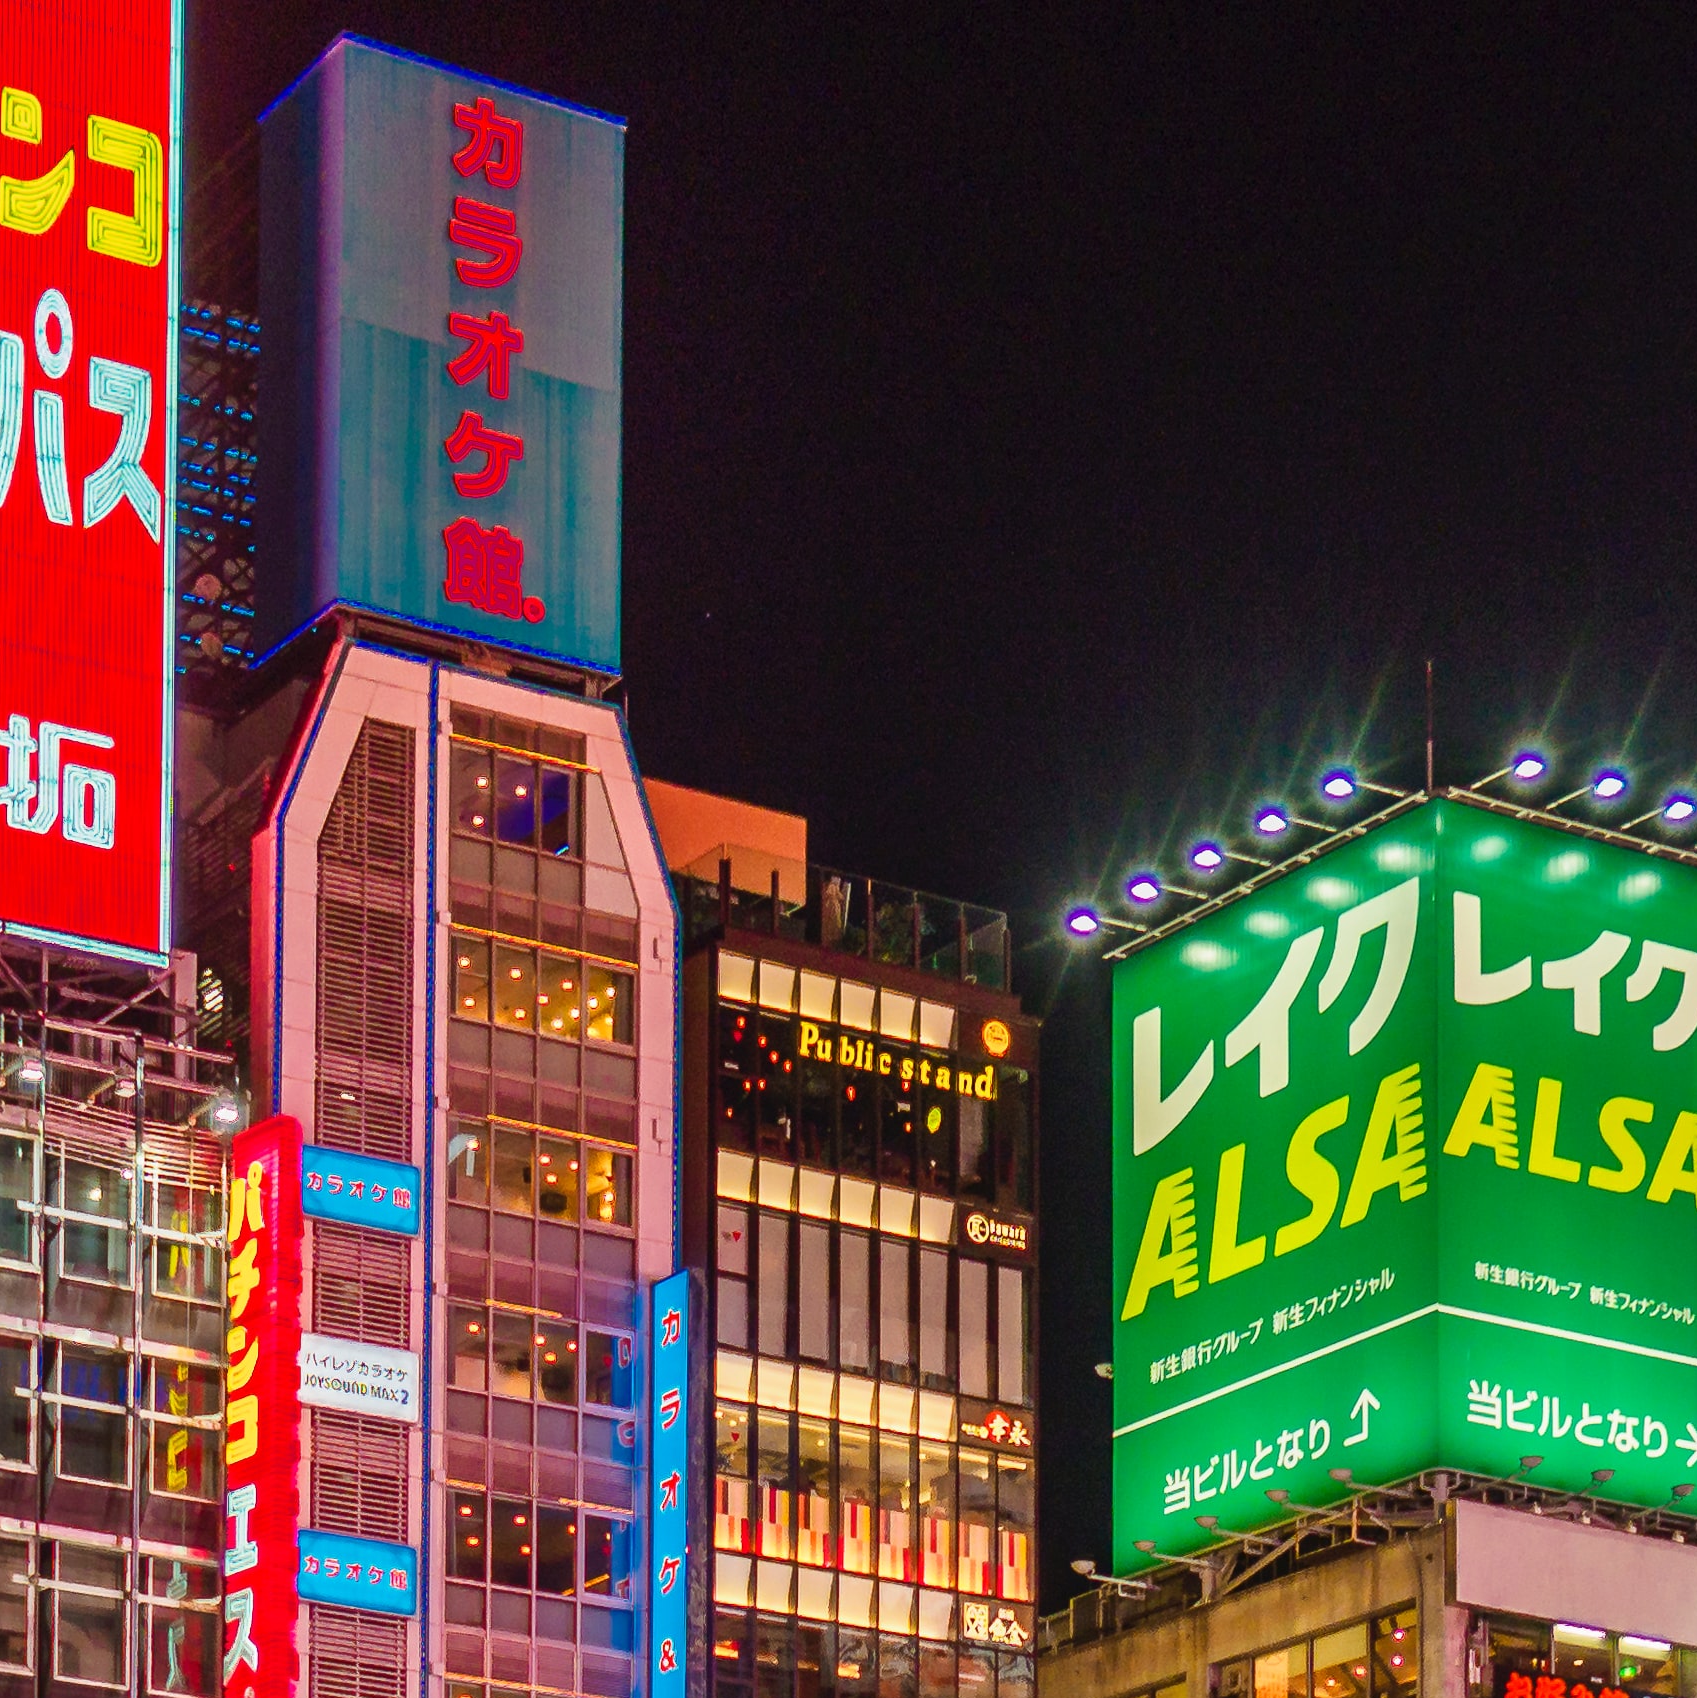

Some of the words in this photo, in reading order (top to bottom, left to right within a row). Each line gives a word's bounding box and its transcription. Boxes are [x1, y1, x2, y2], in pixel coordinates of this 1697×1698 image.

[1131, 876, 1421, 1156] レイク
[798, 1020, 892, 1077] Public
[899, 1055, 998, 1102] stand
[305, 1168, 412, 1211] カラオケ館
[1120, 1061, 1430, 1322] ALSA
[227, 1158, 264, 1467] パチンコ
[1149, 1313, 1263, 1385] 新生銀行グループ
[1272, 1264, 1396, 1337] 新生フィナンシャル
[1473, 1261, 1581, 1301] 新生銀行グループ
[1589, 1285, 1695, 1325] 新生フィナンシャル
[303, 1374, 367, 1401] JOYSOUND
[304, 1350, 409, 1383] ハイレゾカラオケ
[1466, 1377, 1670, 1460] 当ビルとなり
[1162, 1417, 1332, 1516] 当ビルとなり
[303, 1554, 409, 1593] カラオケ館
